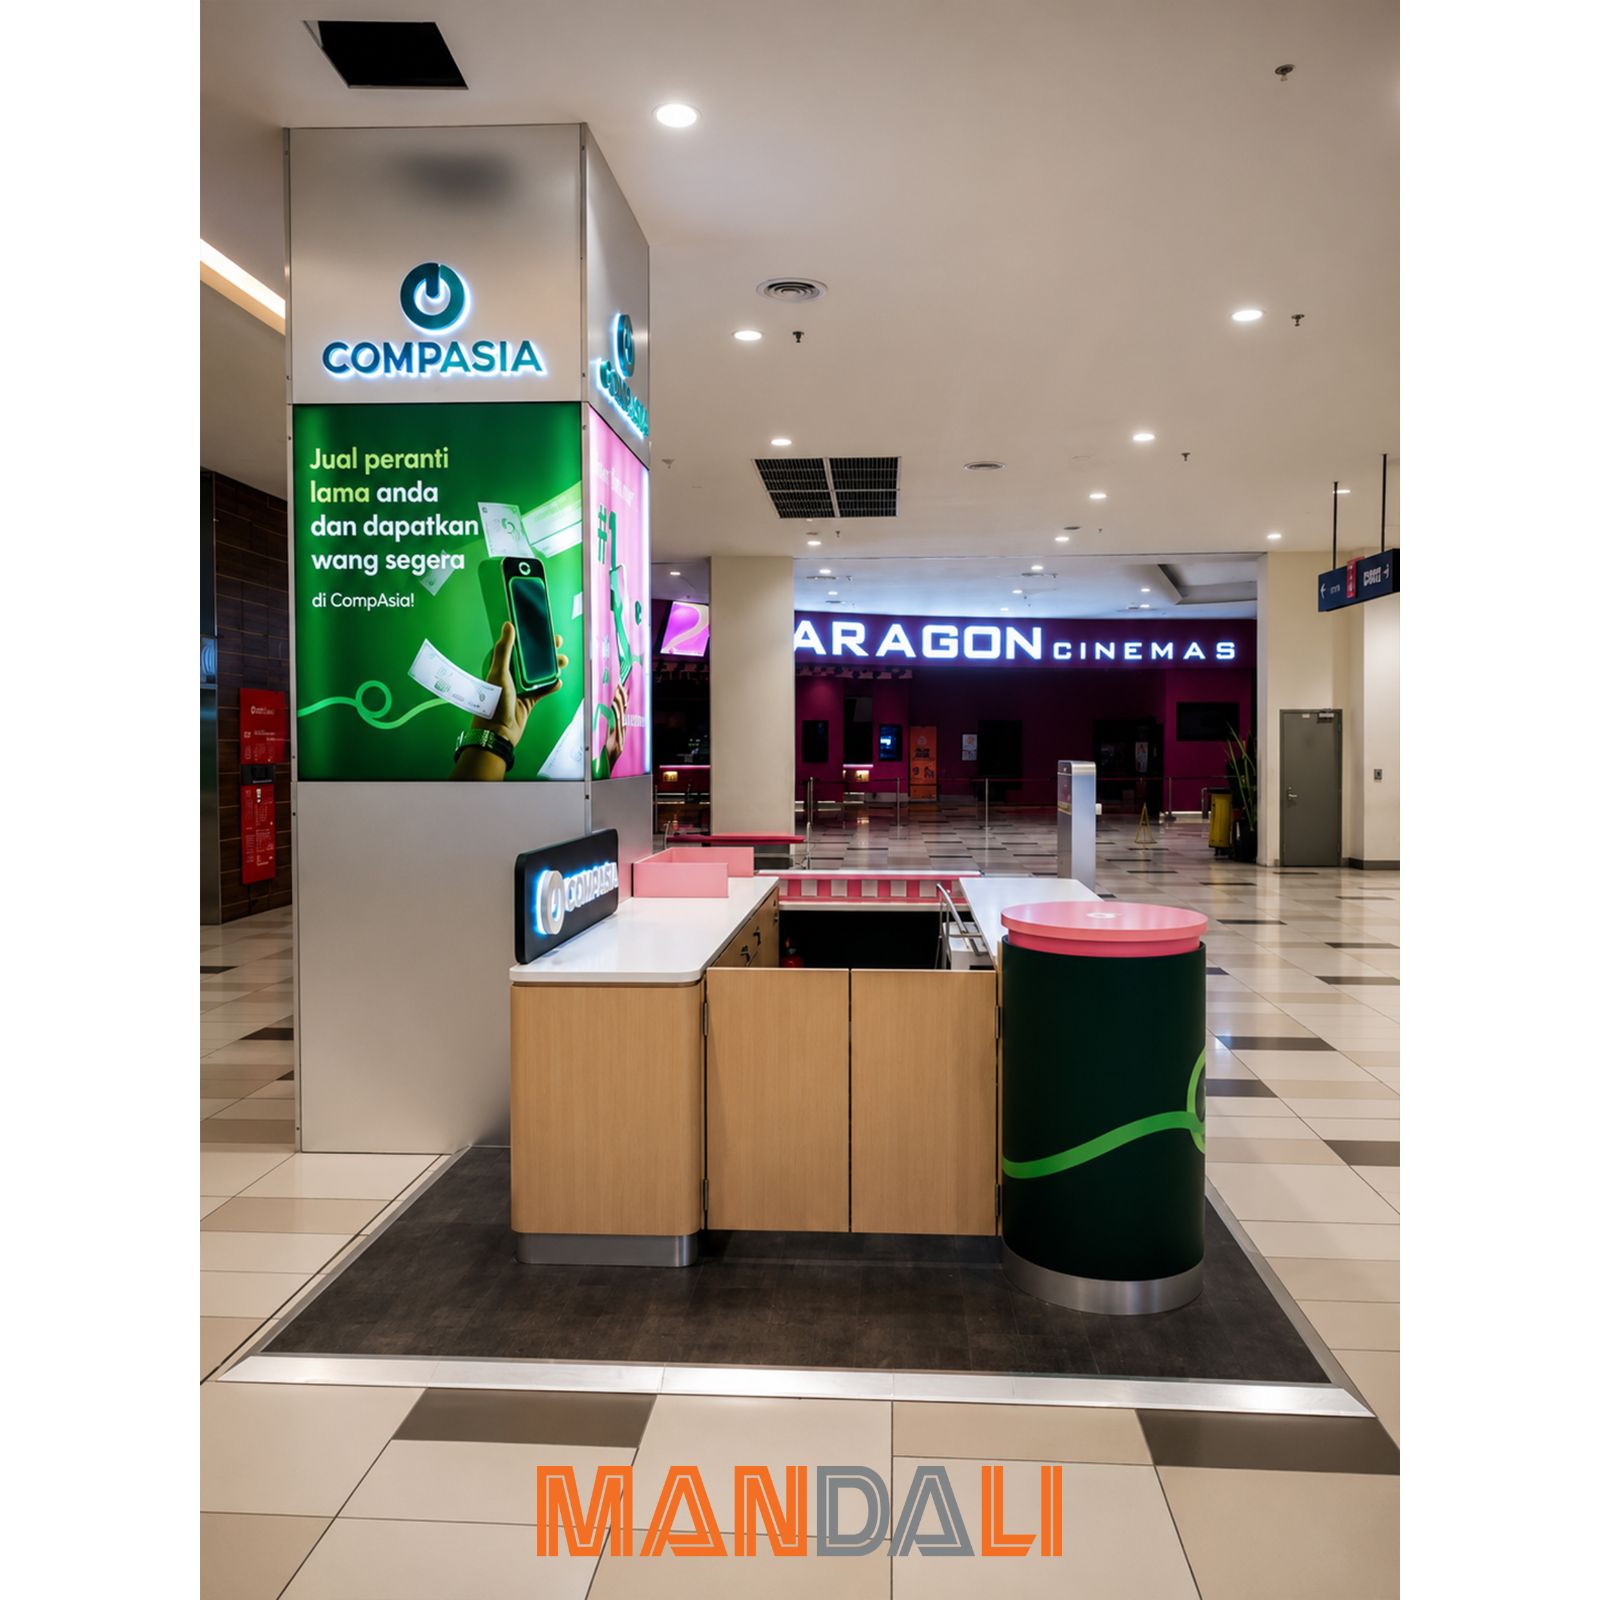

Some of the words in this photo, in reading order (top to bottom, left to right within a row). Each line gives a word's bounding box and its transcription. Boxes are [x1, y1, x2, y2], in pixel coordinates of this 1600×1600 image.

[322, 339, 544, 375] COMPASIA
[310, 446, 357, 469] Jual
[365, 446, 449, 475] peranti
[310, 480, 370, 502] lama
[376, 480, 439, 502] anda
[310, 514, 357, 536] dan
[363, 513, 479, 542] dapatkan
[311, 553, 378, 576] wang
[385, 553, 465, 576] segera
[312, 592, 326, 607] di
[330, 592, 415, 611] CompAsia!
[1053, 641, 1236, 660] CINEMAS
[564, 862, 618, 912] COMPASIA
